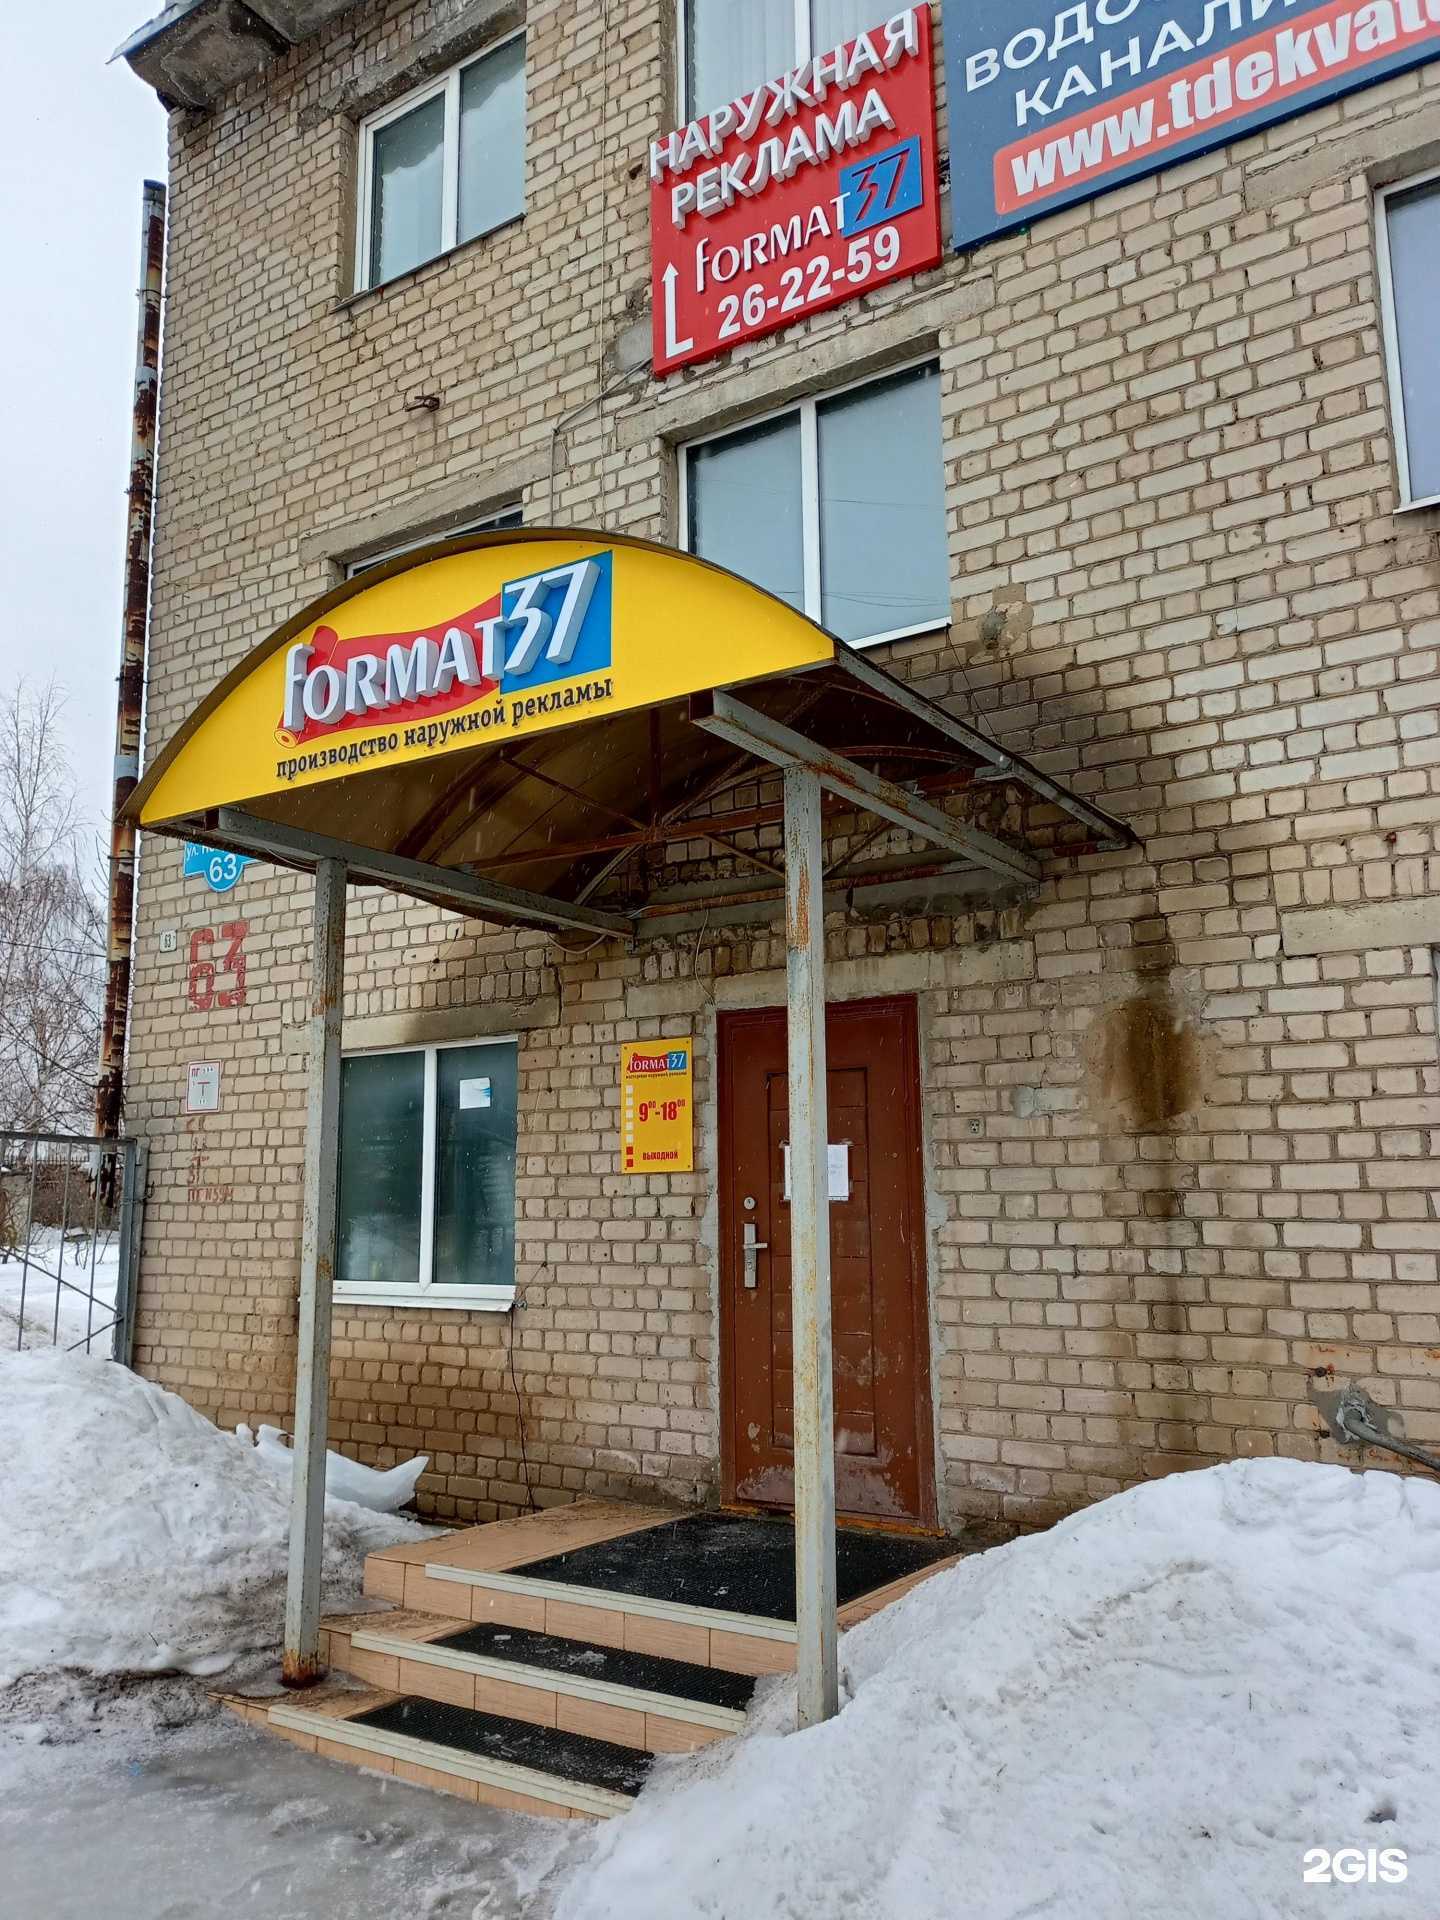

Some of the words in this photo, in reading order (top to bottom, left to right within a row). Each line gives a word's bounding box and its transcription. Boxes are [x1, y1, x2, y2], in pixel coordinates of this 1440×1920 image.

[650, 7, 918, 184] НАРУЖНАЯ
[671, 87, 896, 230] РЕКЛАМА
[717, 226, 901, 340] 26-22-59
[276, 732, 399, 780] производство
[403, 699, 506, 747] наружной
[511, 678, 613, 726] рекламы
[209, 853, 238, 882] 63
